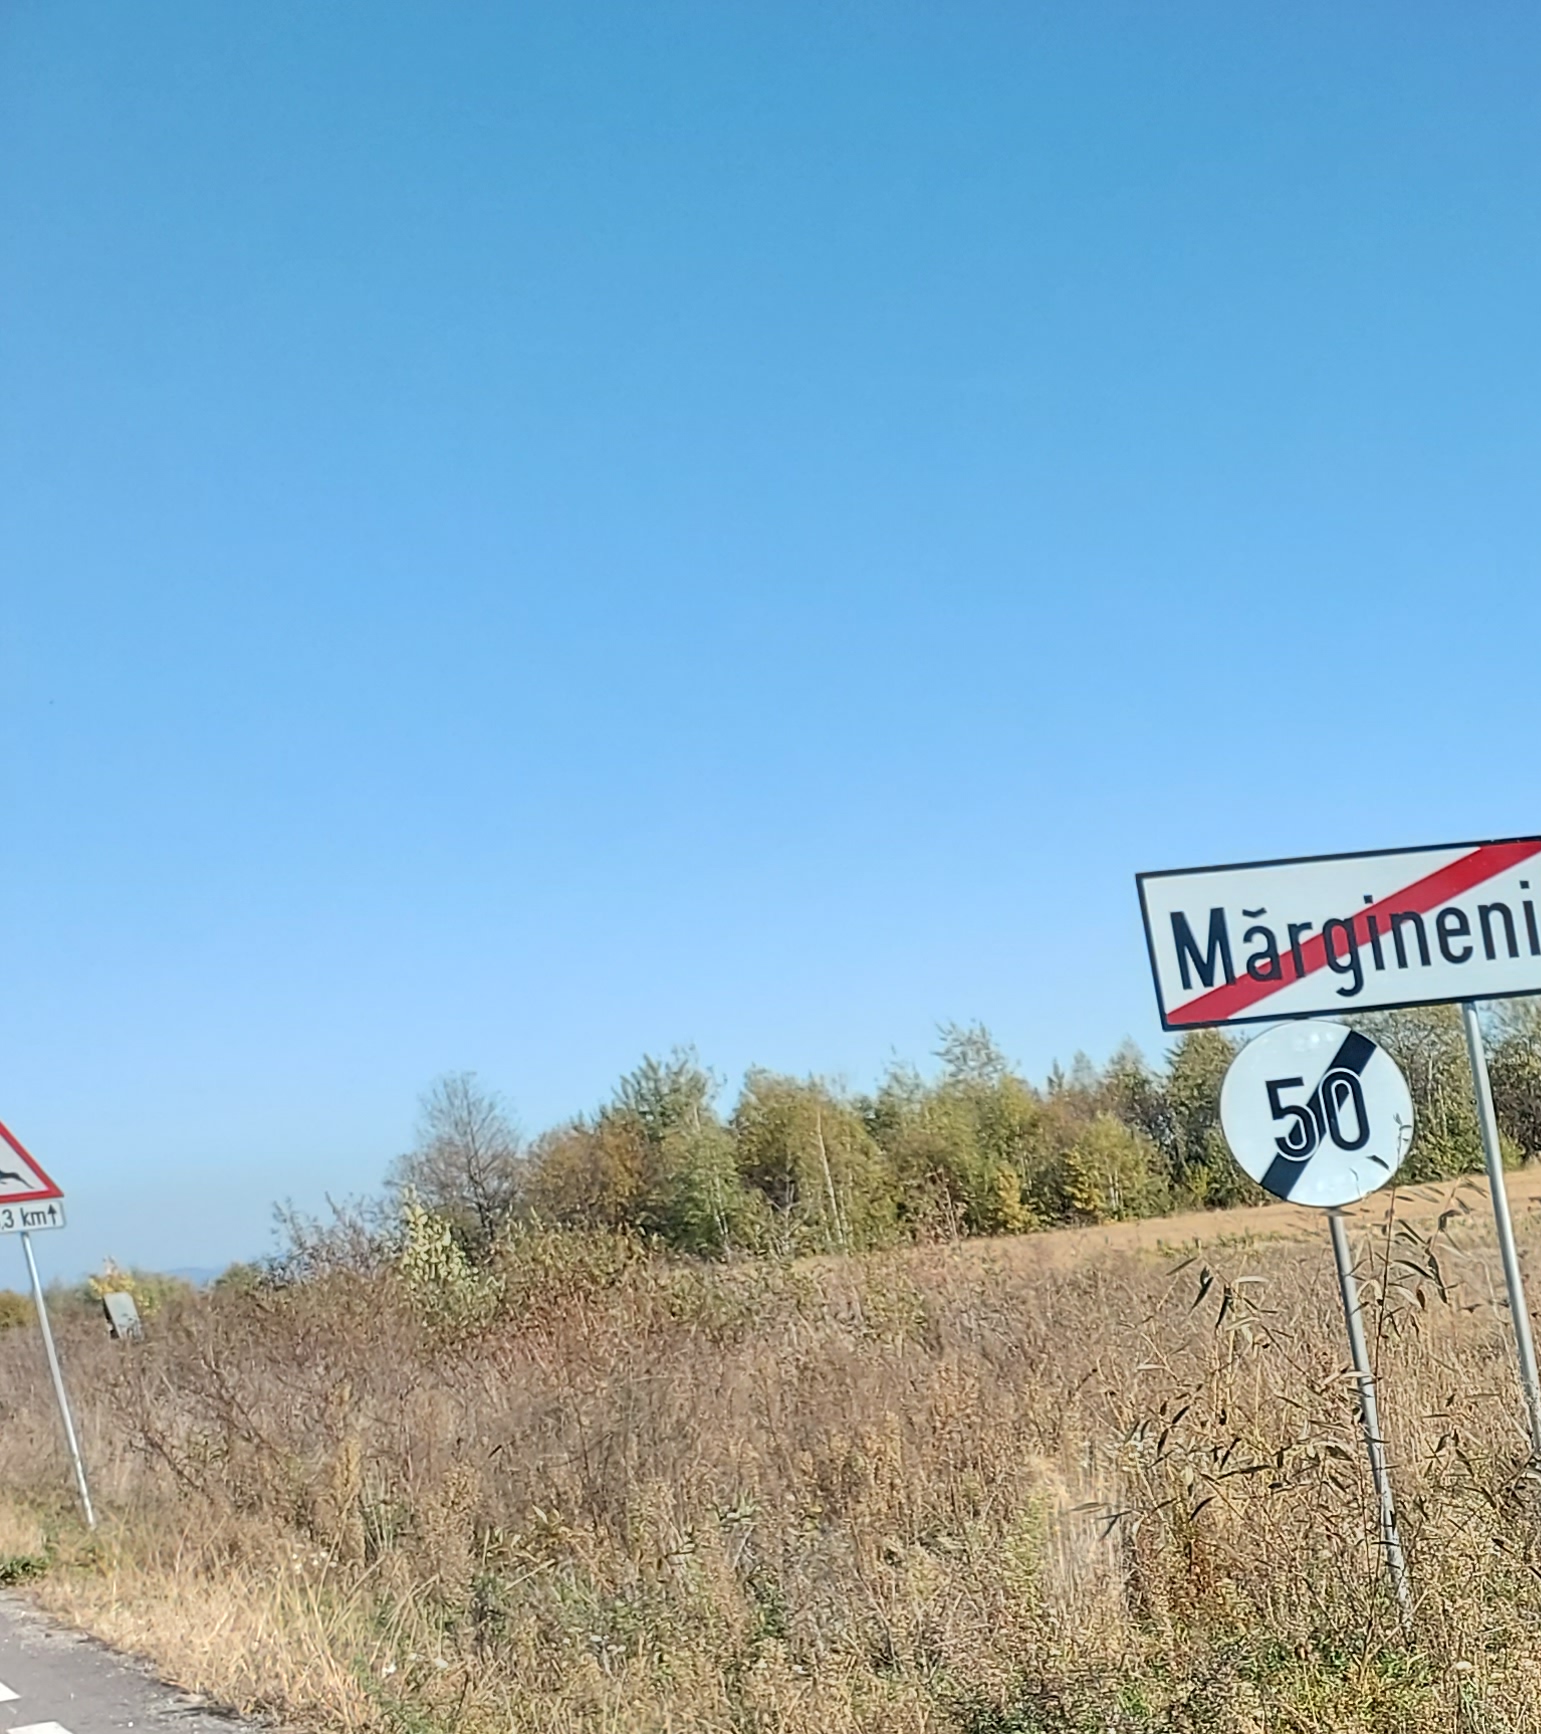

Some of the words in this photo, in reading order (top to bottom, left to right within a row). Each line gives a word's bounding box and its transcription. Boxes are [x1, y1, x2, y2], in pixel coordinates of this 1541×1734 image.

[1265, 1069, 1371, 1159] 50
[0, 1208, 15, 1230] ,3
[20, 1206, 48, 1227] km
